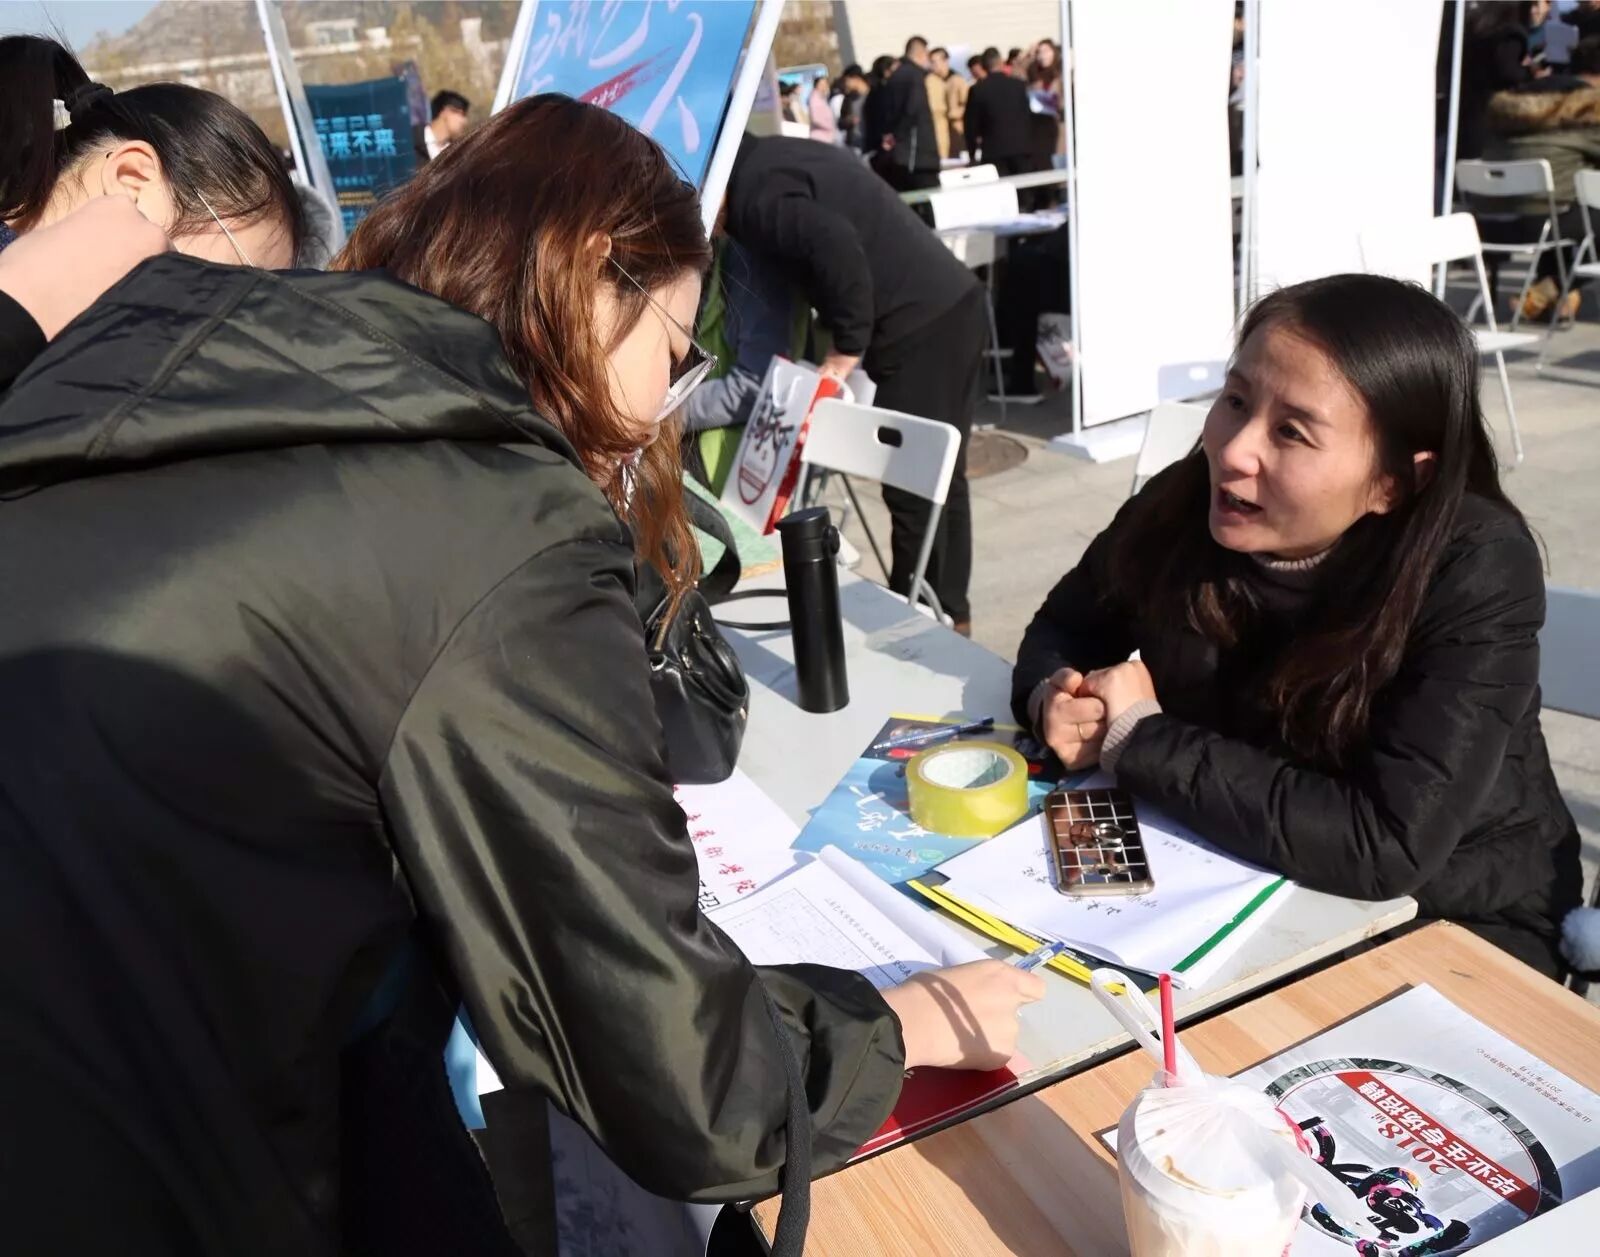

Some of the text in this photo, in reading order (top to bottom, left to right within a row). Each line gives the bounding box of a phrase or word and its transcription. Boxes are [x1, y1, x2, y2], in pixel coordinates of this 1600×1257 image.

[1519, 1065, 1562, 1093] 2017年11月
[1355, 1082, 1520, 1196] 毕业生专场招聘
